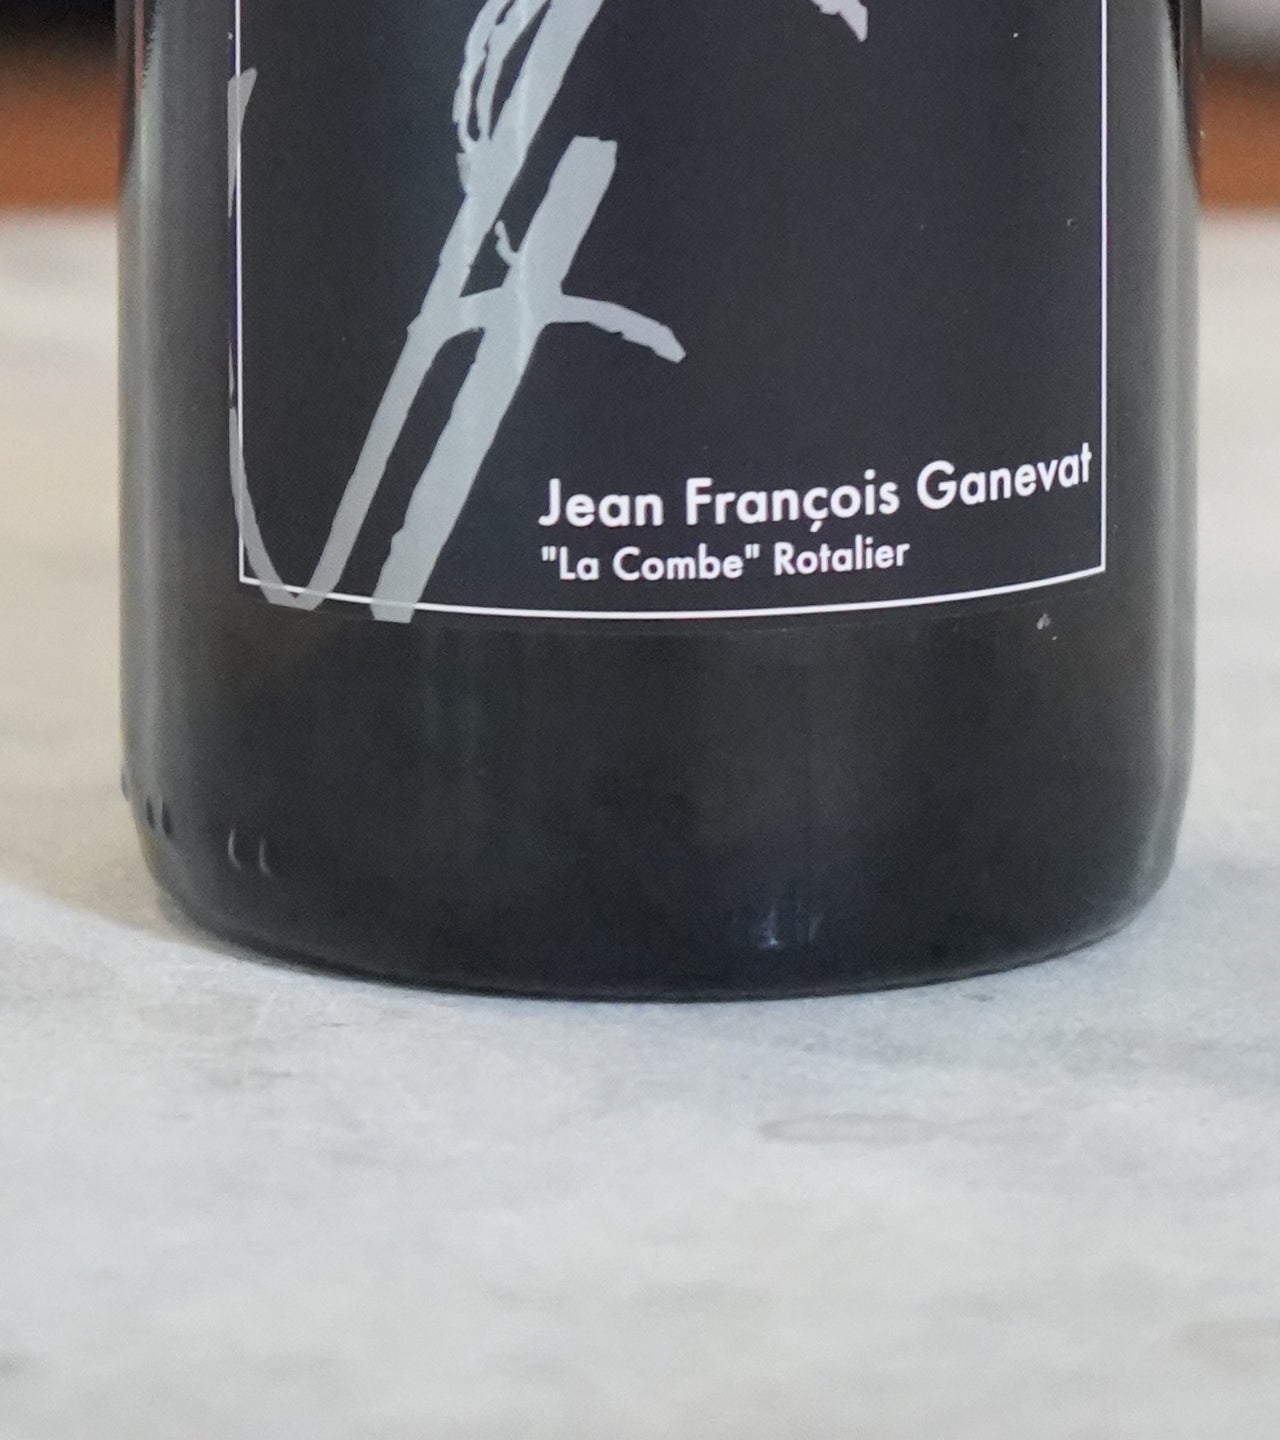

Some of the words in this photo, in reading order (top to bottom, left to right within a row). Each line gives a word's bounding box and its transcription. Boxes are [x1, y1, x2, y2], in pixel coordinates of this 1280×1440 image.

[539, 477, 664, 527] Jean
[685, 468, 900, 533] François
[916, 442, 1093, 510] Ganevat
[541, 545, 600, 581] "La
[612, 542, 761, 581] Combe"
[773, 533, 911, 576] Rotalier
